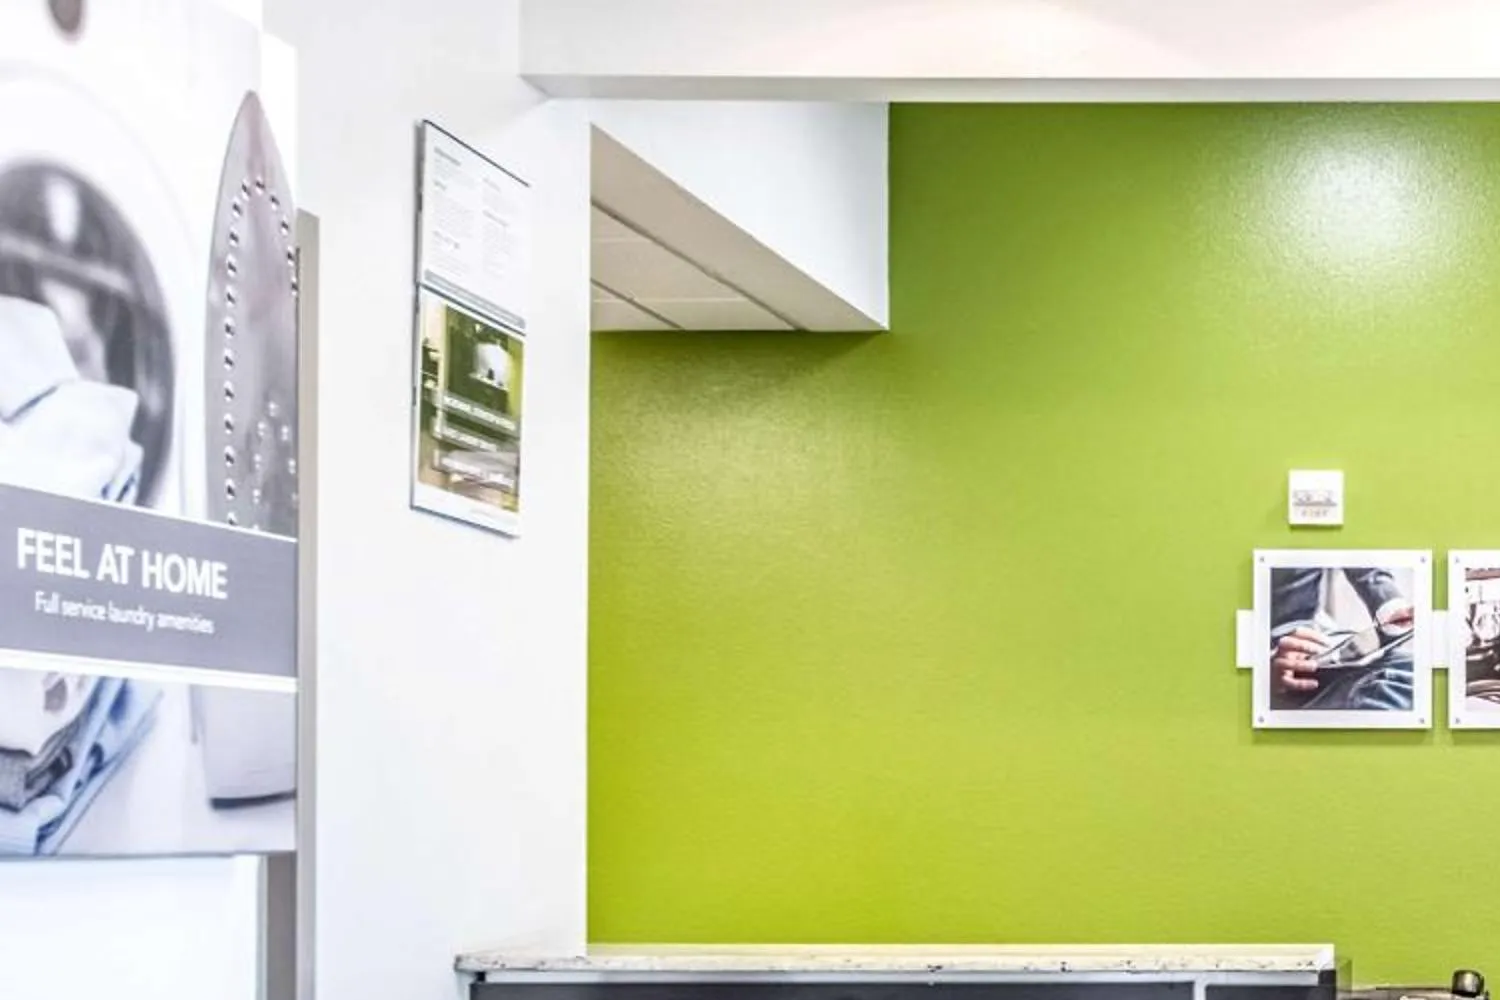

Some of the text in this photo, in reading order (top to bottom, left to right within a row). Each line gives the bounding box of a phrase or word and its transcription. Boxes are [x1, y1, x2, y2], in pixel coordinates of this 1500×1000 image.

[17, 527, 229, 599] FEEL AT HOME
[35, 590, 59, 614] Full
[62, 598, 106, 621] service
[108, 600, 154, 632] laundry
